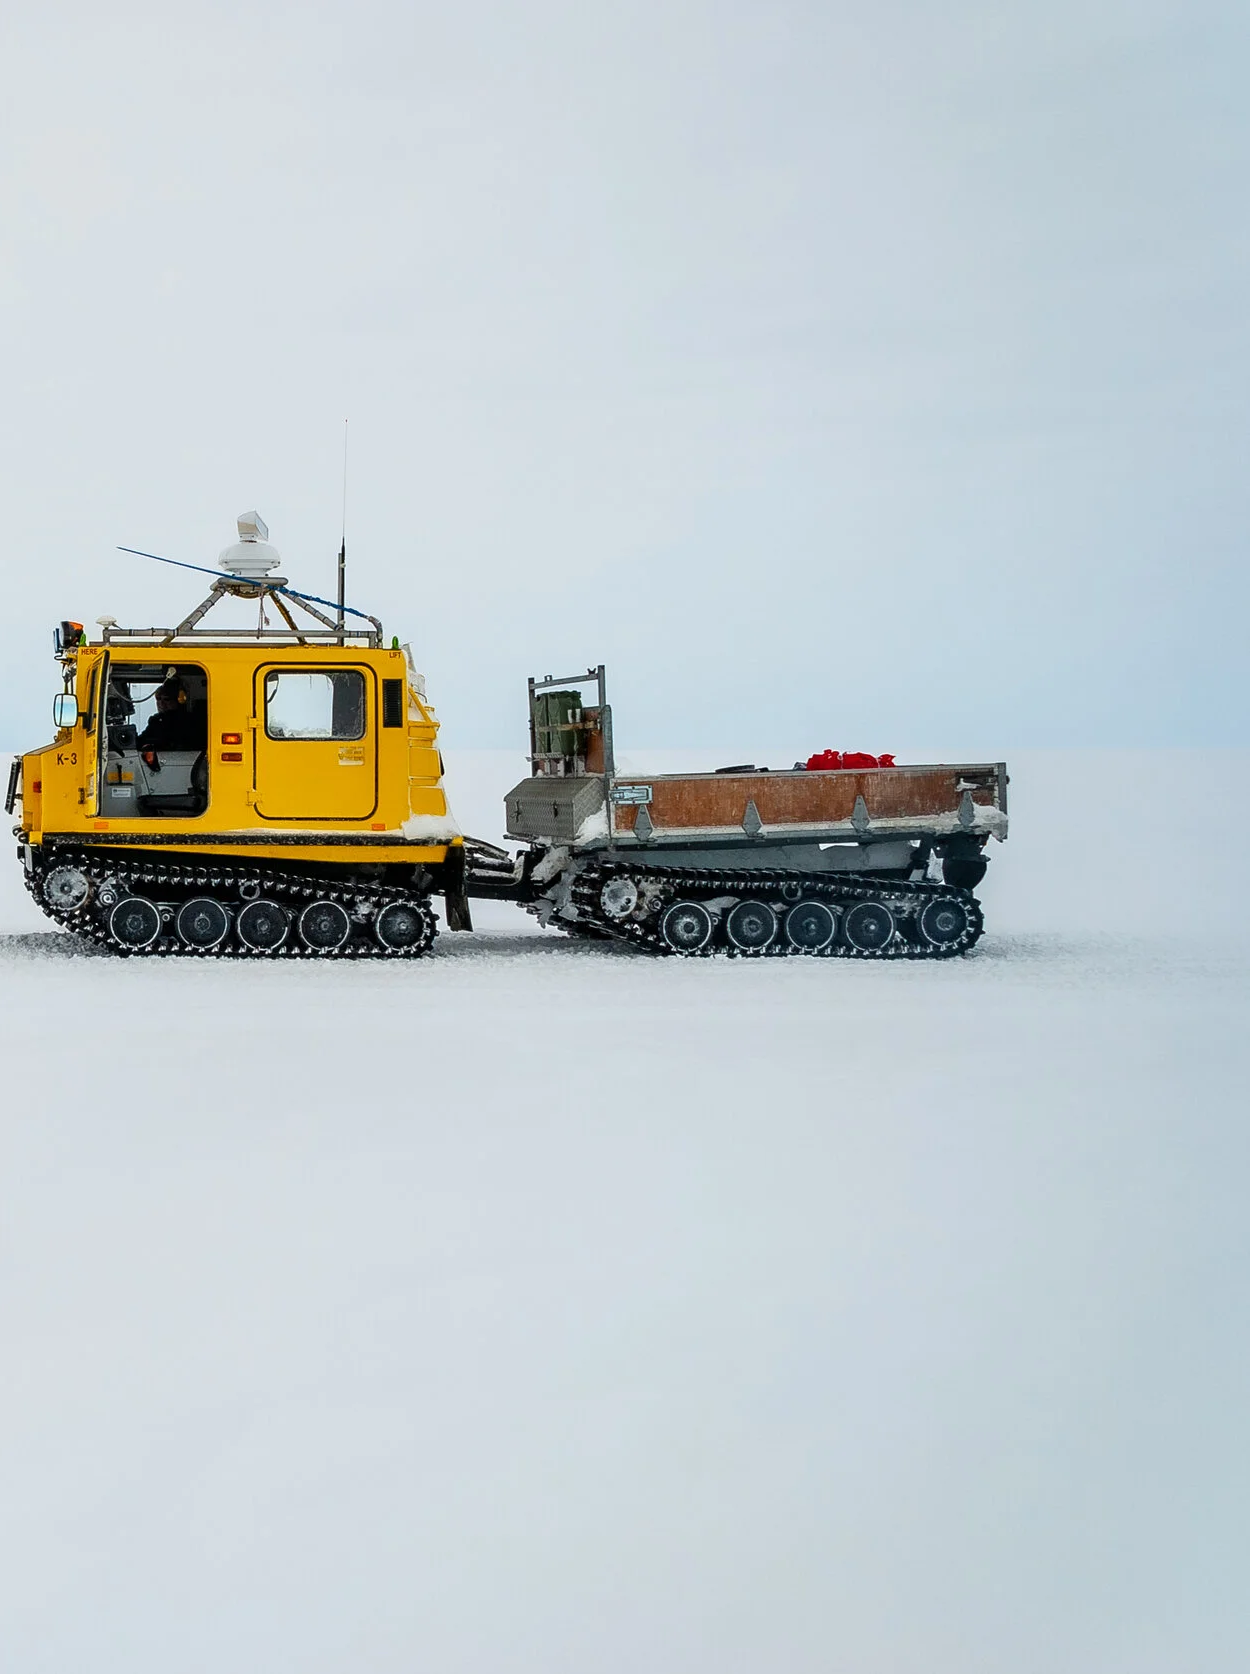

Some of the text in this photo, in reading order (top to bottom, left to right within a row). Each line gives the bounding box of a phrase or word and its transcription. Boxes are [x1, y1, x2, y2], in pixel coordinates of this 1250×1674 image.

[81, 648, 98, 656] HERE
[389, 651, 401, 659] LIFT
[56, 752, 78, 766] K-3
